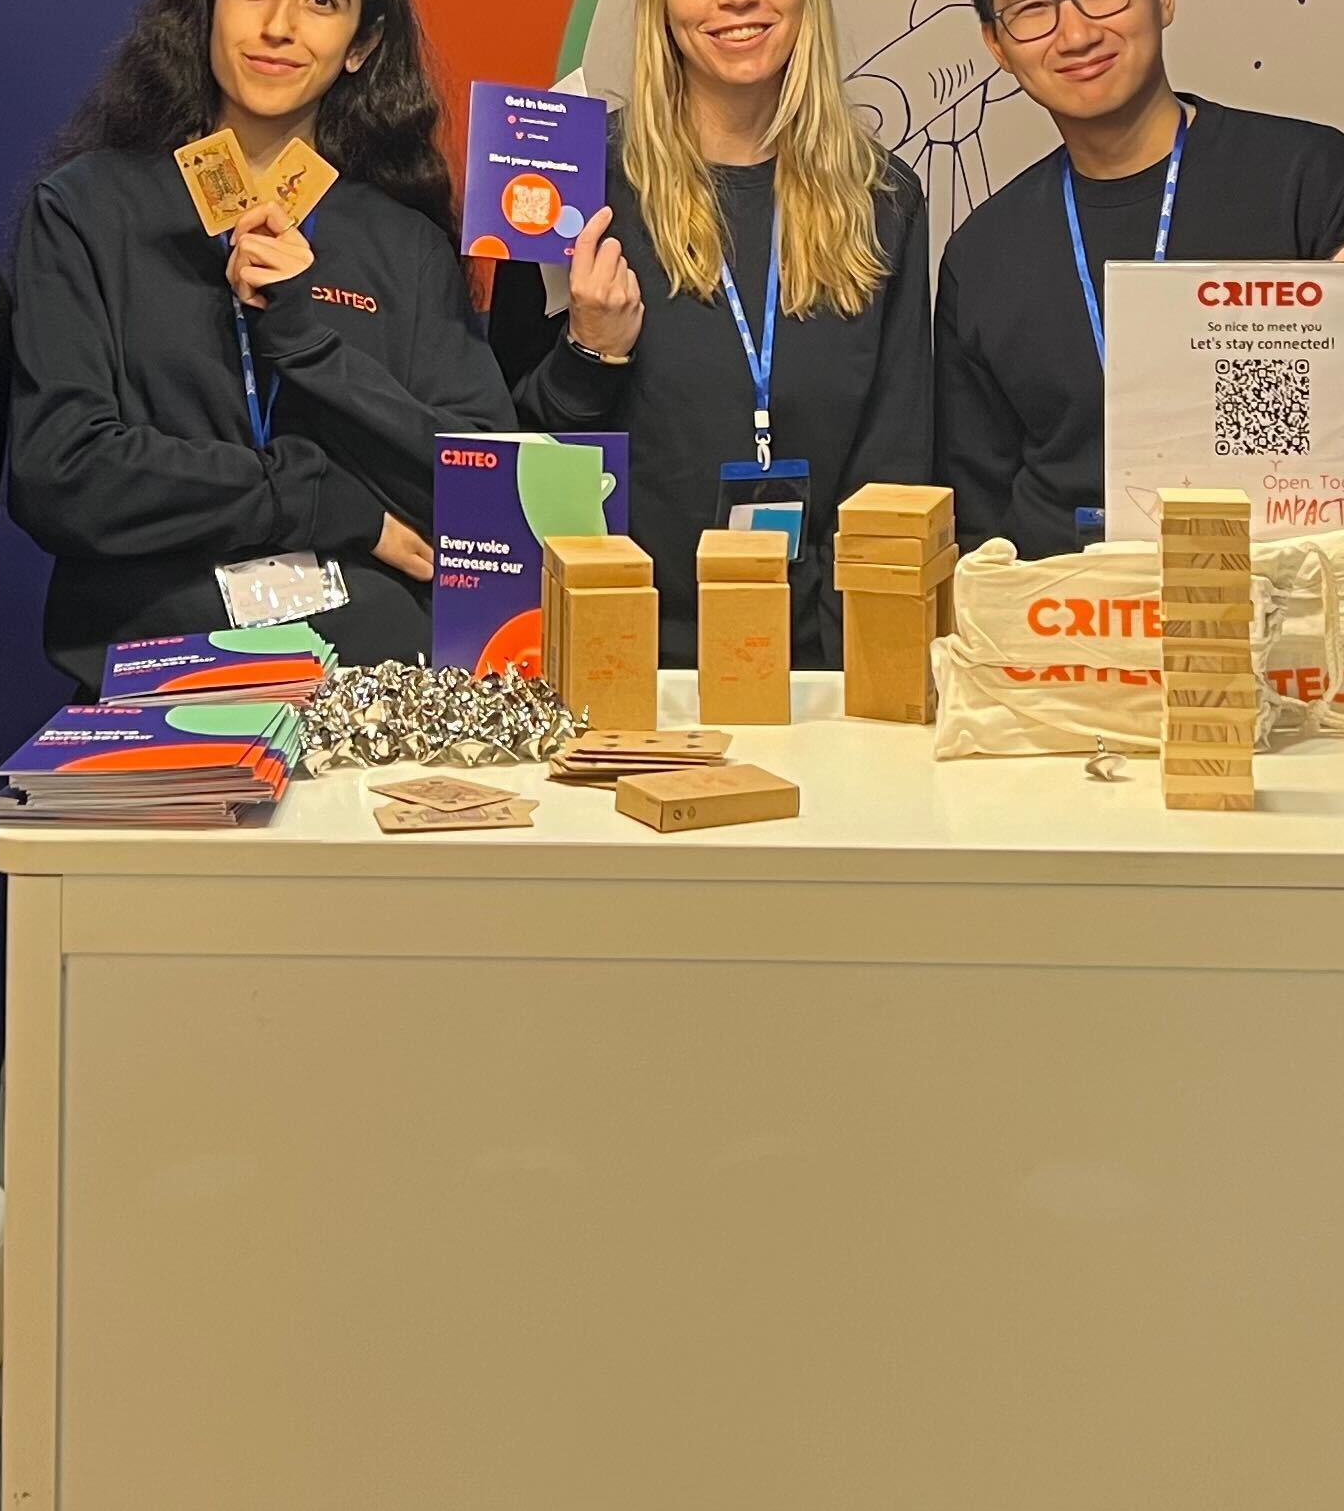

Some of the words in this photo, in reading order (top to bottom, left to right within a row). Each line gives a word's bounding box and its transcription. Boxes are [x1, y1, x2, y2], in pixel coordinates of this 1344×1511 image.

[311, 286, 377, 313] CRITEO
[1197, 281, 1323, 307] CRITEO
[1207, 322, 1222, 332] So
[1224, 322, 1249, 332] nice
[1252, 322, 1264, 332] to
[1267, 322, 1297, 332] meet
[1300, 324, 1322, 334] you
[1190, 337, 1222, 350] Let's
[1226, 339, 1254, 352] stay
[1257, 337, 1335, 350] connected!
[440, 449, 498, 469] CRITEO
[440, 536, 475, 554] Every
[477, 539, 510, 555] voice
[501, 561, 524, 575] our
